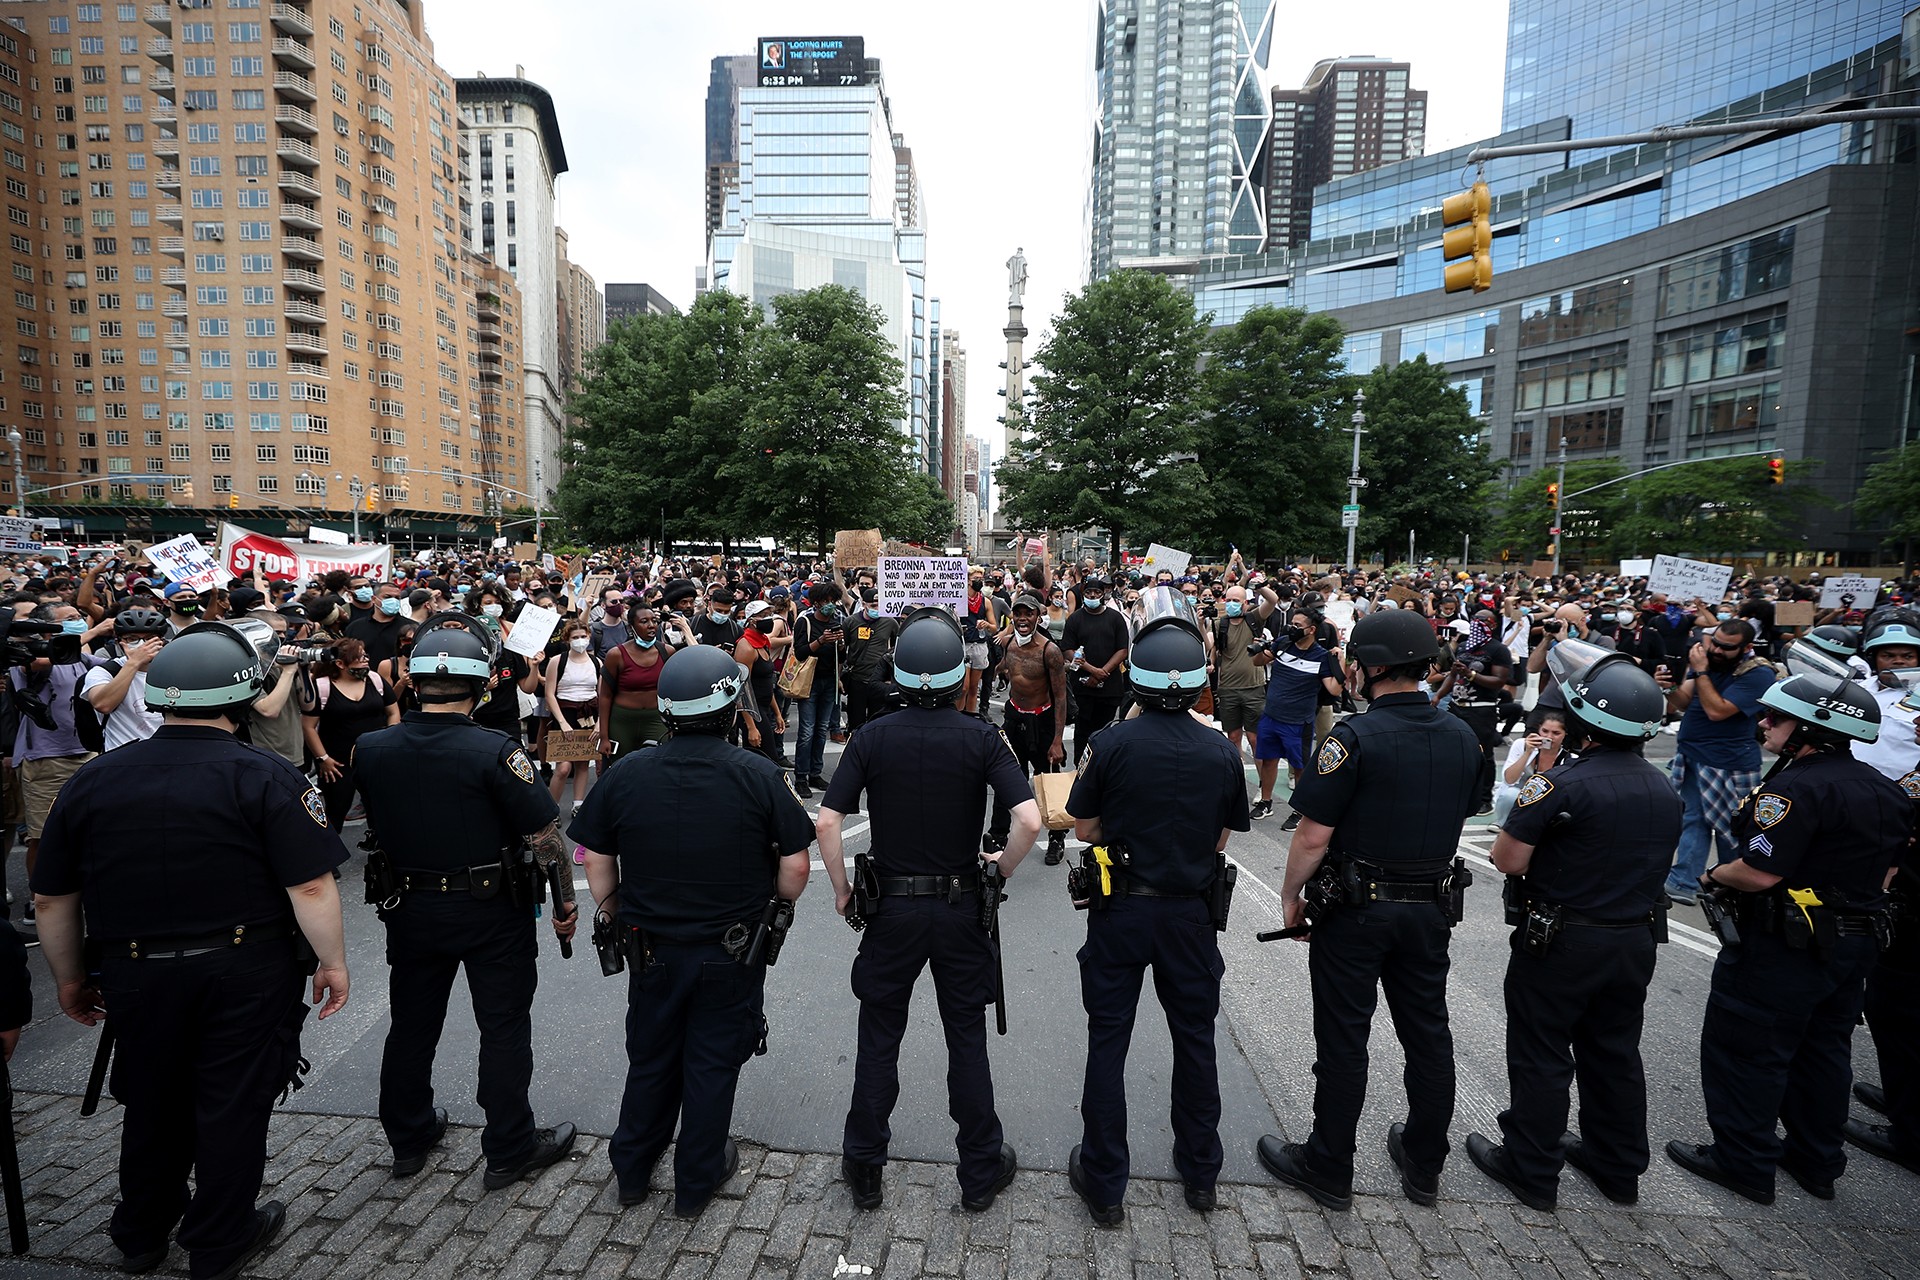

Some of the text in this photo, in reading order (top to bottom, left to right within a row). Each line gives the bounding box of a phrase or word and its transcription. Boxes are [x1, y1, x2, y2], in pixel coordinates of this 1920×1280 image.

[762, 76, 803, 85] 6:32 PM
[840, 76, 857, 85] 77°
[172, 540, 199, 555] WITH
[839, 538, 877, 547] KILLING
[843, 547, 876, 557] BLACK
[234, 547, 296, 575] STOP
[840, 556, 877, 567] PEOPLE
[884, 560, 963, 571] BREONNA TAYLOR
[306, 559, 383, 578] TRUMP'S
[1665, 567, 1699, 579] BLACK
[884, 572, 900, 580] WAS
[904, 572, 920, 580] KIND
[939, 572, 965, 580] HONEST.
[884, 581, 896, 589] SHE
[902, 581, 916, 589] WAS
[884, 590, 905, 598] LOVED
[909, 590, 934, 598] HELPING
[885, 601, 904, 616] SAY
[1597, 699, 1609, 709] 6
[1817, 697, 1866, 718] 27255
